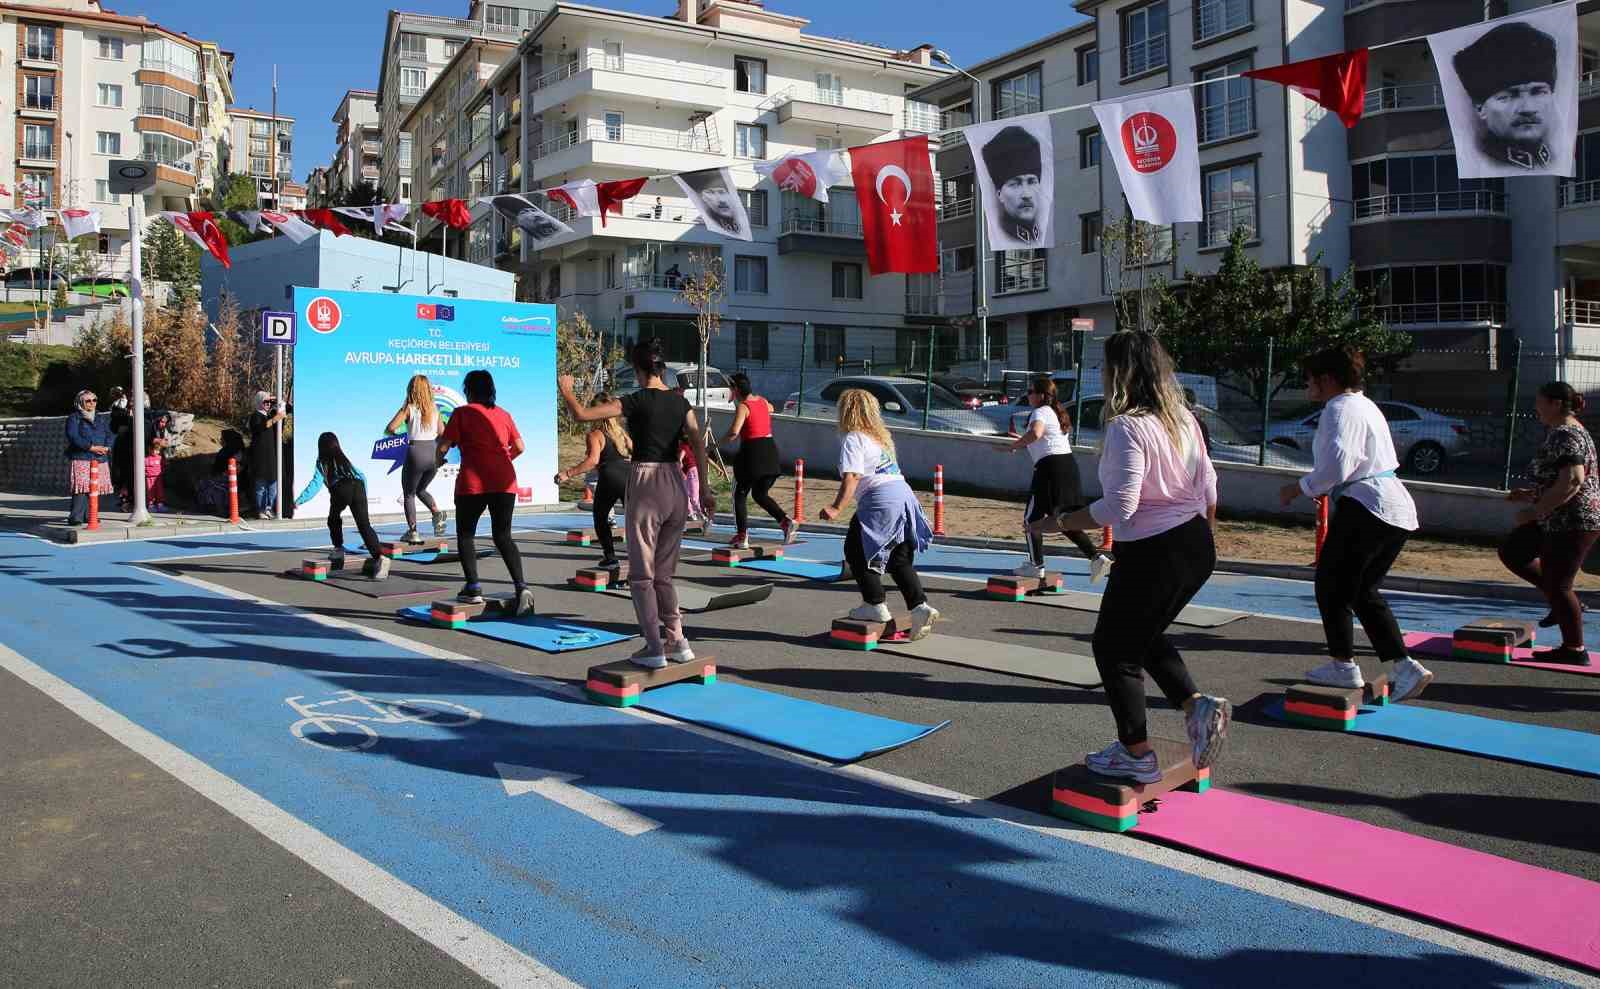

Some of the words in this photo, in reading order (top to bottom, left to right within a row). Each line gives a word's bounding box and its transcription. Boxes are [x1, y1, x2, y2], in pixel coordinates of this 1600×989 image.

[272, 319, 288, 337] D
[344, 351, 393, 365] AVRUPA
[396, 352, 475, 368] HAREKETLİLİK
[476, 355, 521, 369] HAFTASI
